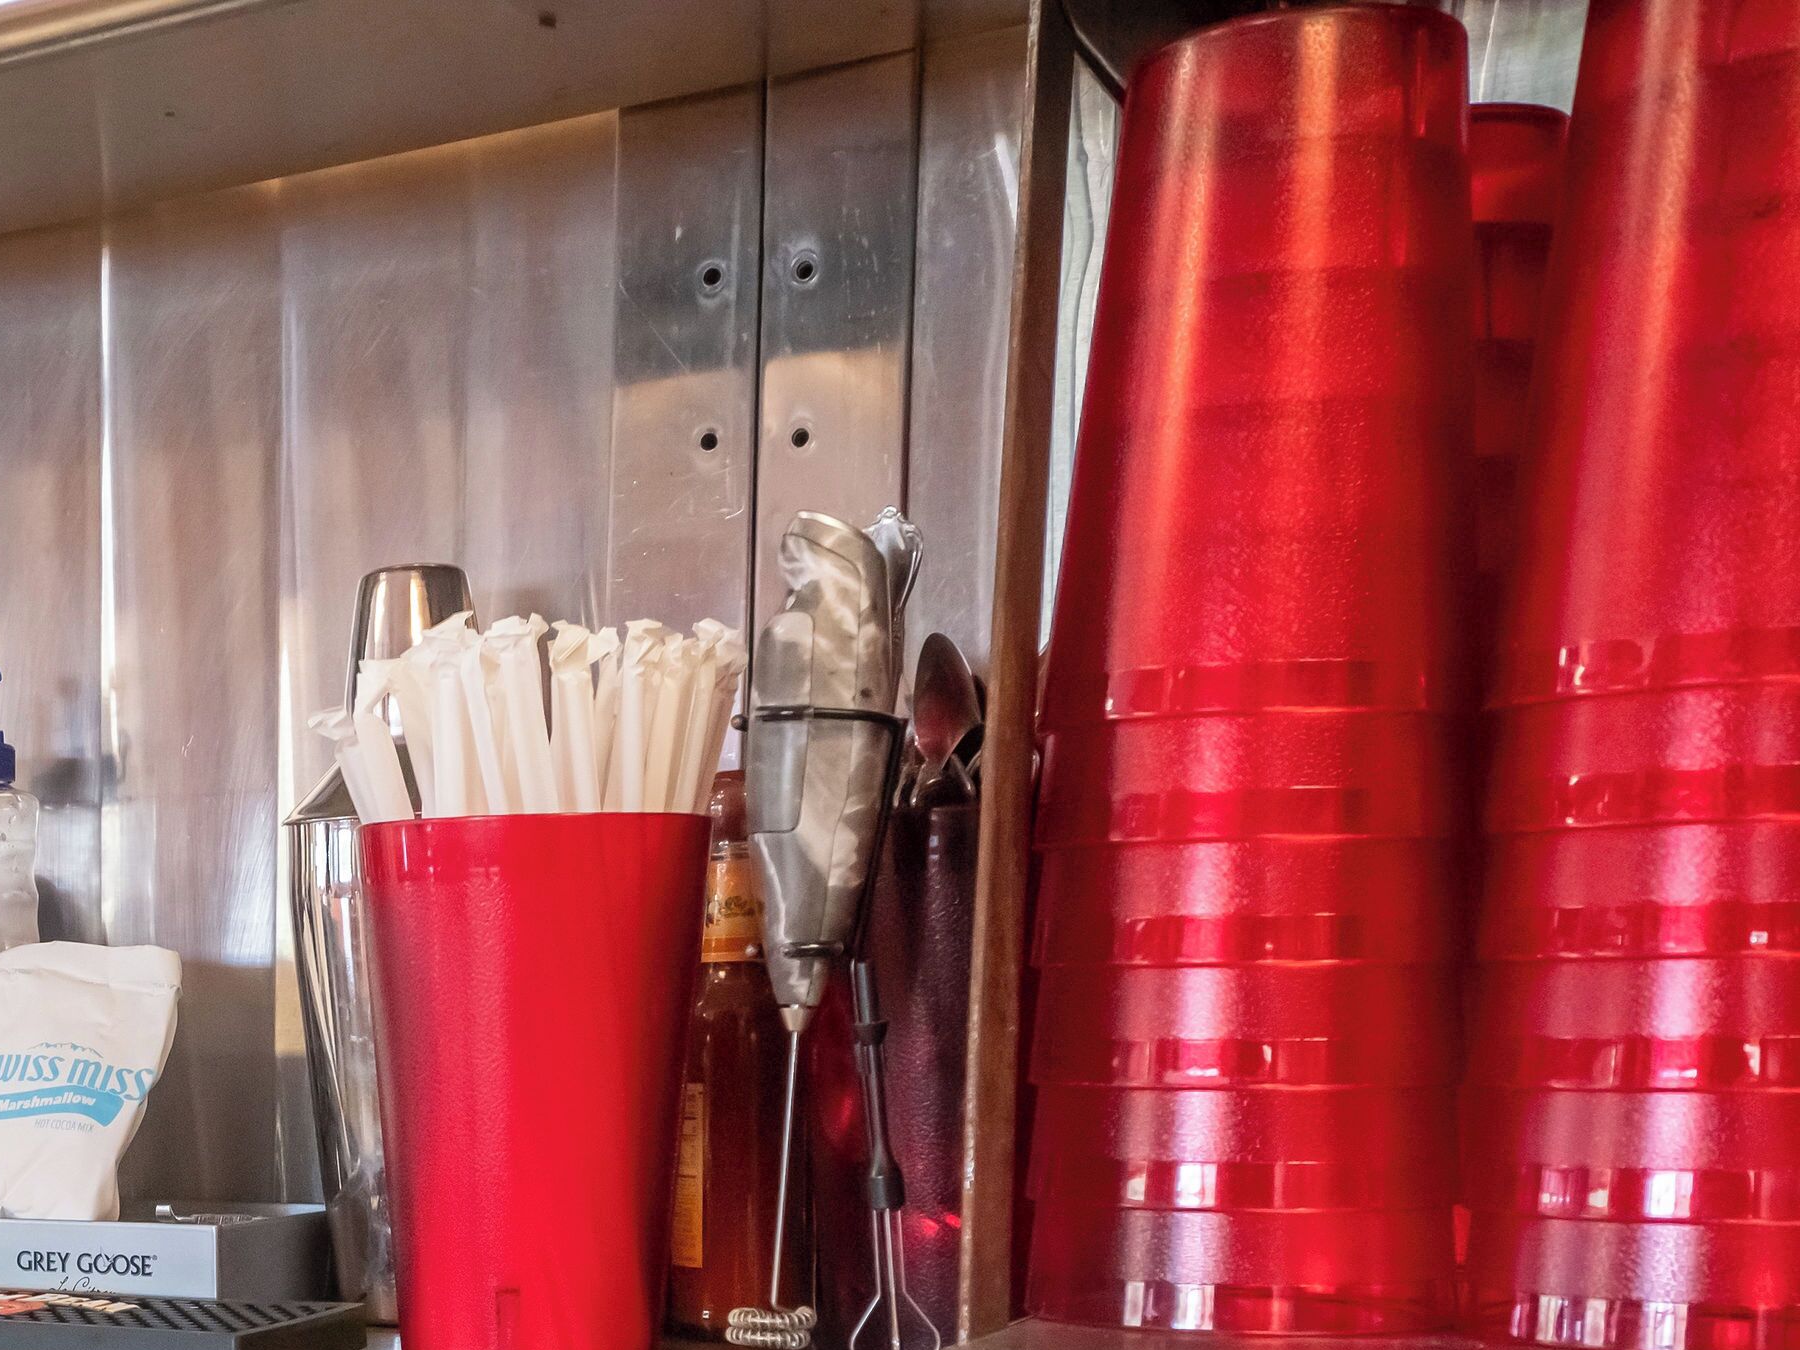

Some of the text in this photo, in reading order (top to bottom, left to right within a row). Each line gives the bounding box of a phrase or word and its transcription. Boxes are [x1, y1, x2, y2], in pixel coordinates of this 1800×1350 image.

[34, 1119, 95, 1133] HOT COCOA MIX
[16, 1250, 153, 1277] GREY GOOSE
